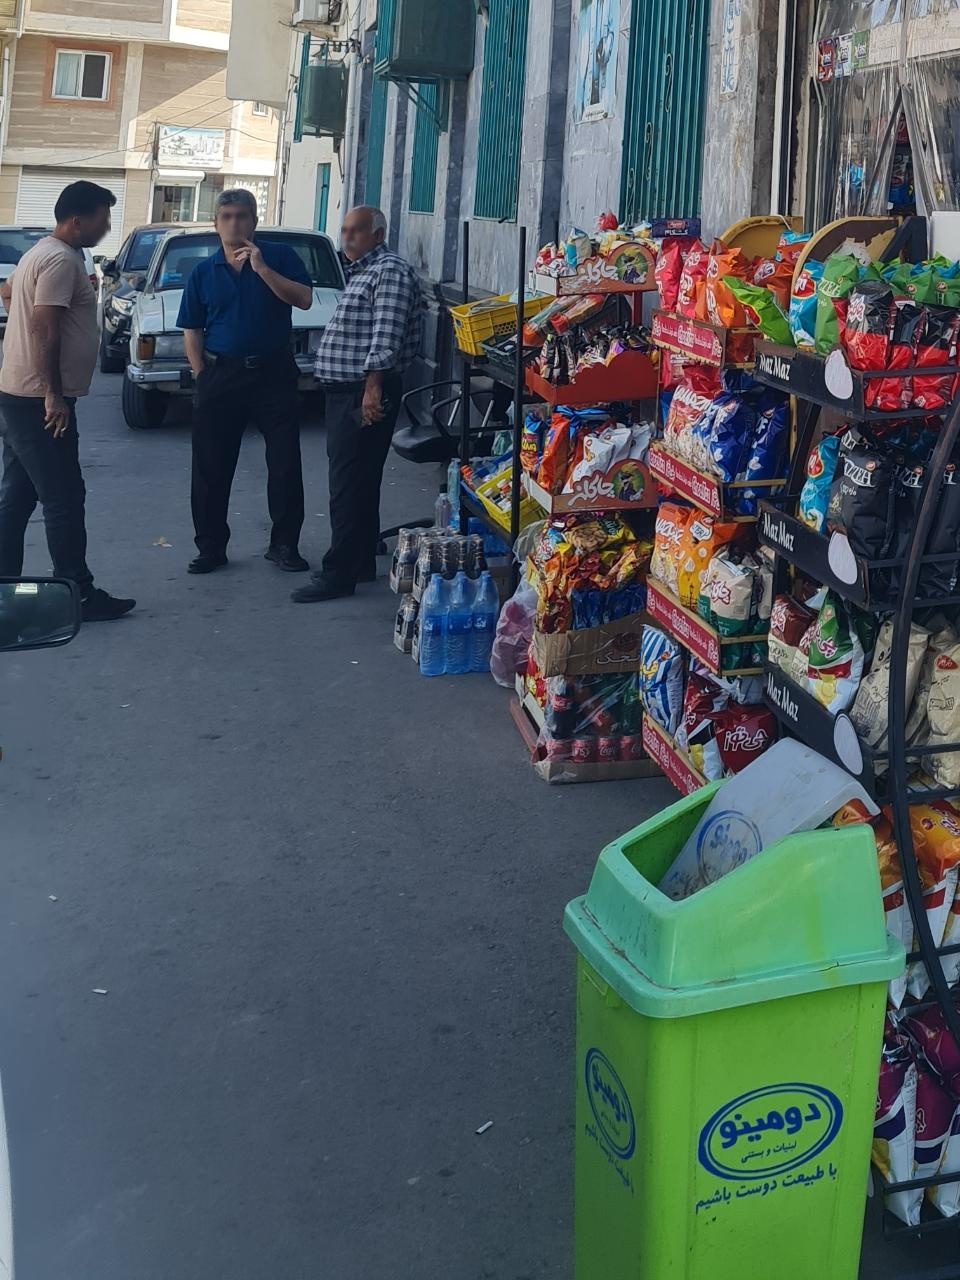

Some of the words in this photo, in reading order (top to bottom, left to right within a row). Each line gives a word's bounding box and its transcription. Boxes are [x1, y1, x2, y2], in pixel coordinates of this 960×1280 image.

[773, 355, 790, 380] Maz
[763, 513, 779, 541] Maz
[778, 522, 794, 551] Maz
[767, 672, 782, 707] Maz
[781, 687, 799, 721] Maz
[719, 1103, 821, 1149] دومینو
[741, 1148, 764, 1164] بستنی
[766, 1148, 771, 1157] و
[773, 1140, 796, 1153] لبنیات
[782, 1165, 824, 1187] طبیعت
[829, 1163, 837, 1181] با
[736, 1179, 777, 1197] دوست
[695, 1187, 732, 1216] باشیم
